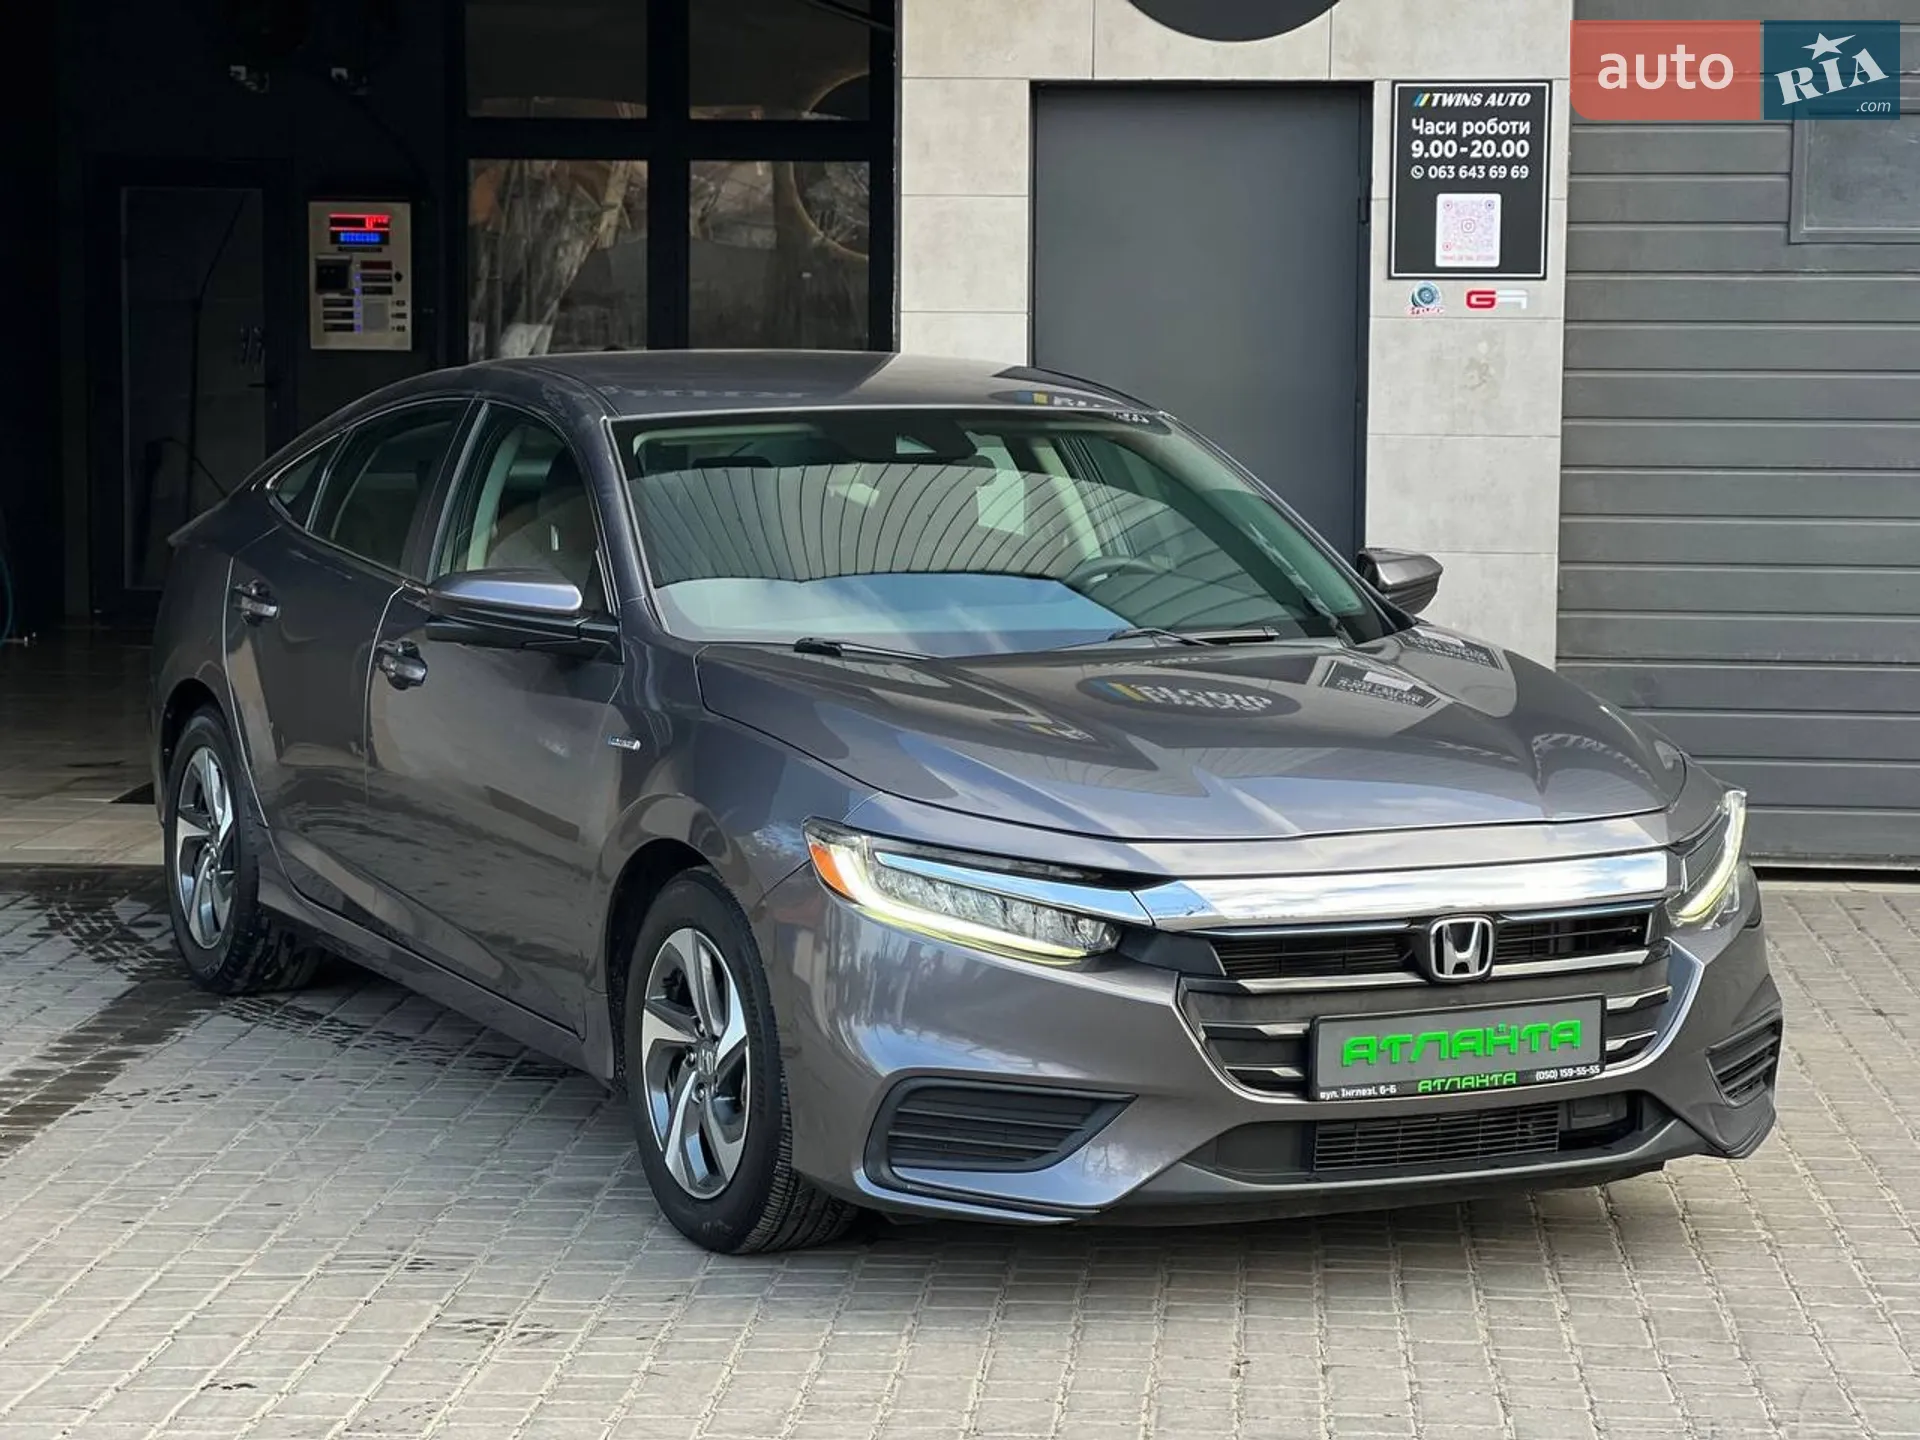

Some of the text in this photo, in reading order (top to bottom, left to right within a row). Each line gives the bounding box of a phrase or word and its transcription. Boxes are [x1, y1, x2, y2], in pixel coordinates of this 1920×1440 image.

[1431, 93, 1531, 107] TWINS AUTO
[1412, 118, 1531, 138] Часи роботи
[1428, 165, 1529, 178] 063 643 69 69
[1535, 1069, 1558, 1081] (050)
